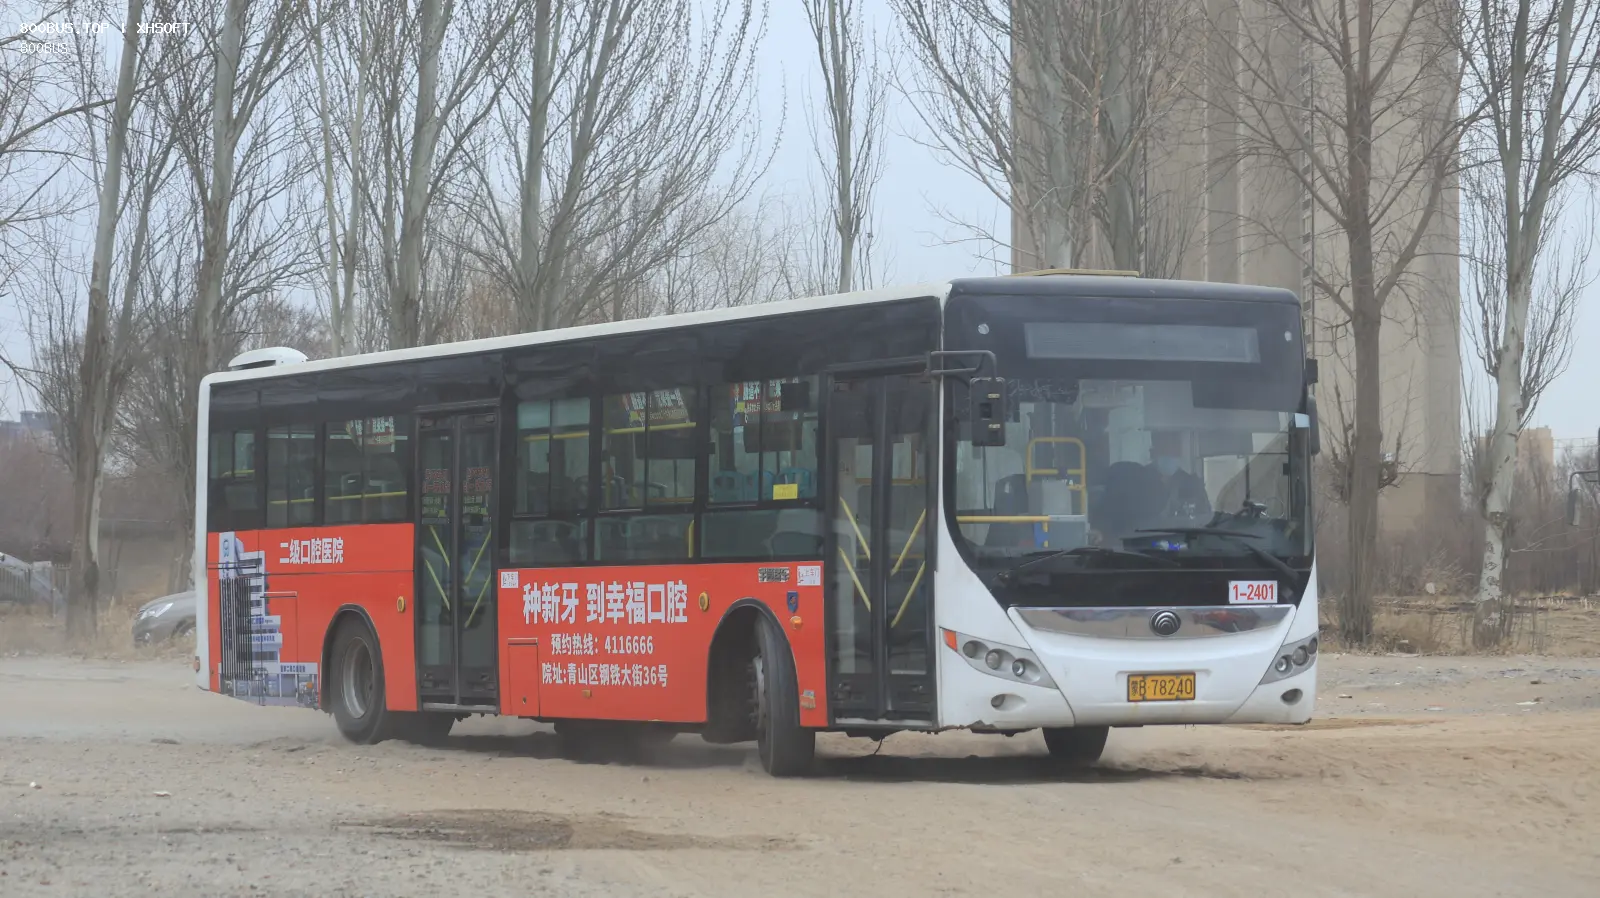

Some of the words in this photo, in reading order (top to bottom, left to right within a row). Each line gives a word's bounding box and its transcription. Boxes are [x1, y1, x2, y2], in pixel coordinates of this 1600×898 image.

[279, 536, 344, 564] 二级口腔医院
[522, 581, 580, 625] 种新牙
[586, 579, 688, 625] 到幸福口腔
[1232, 583, 1275, 601] 1-2401
[604, 635, 654, 655] 4116666
